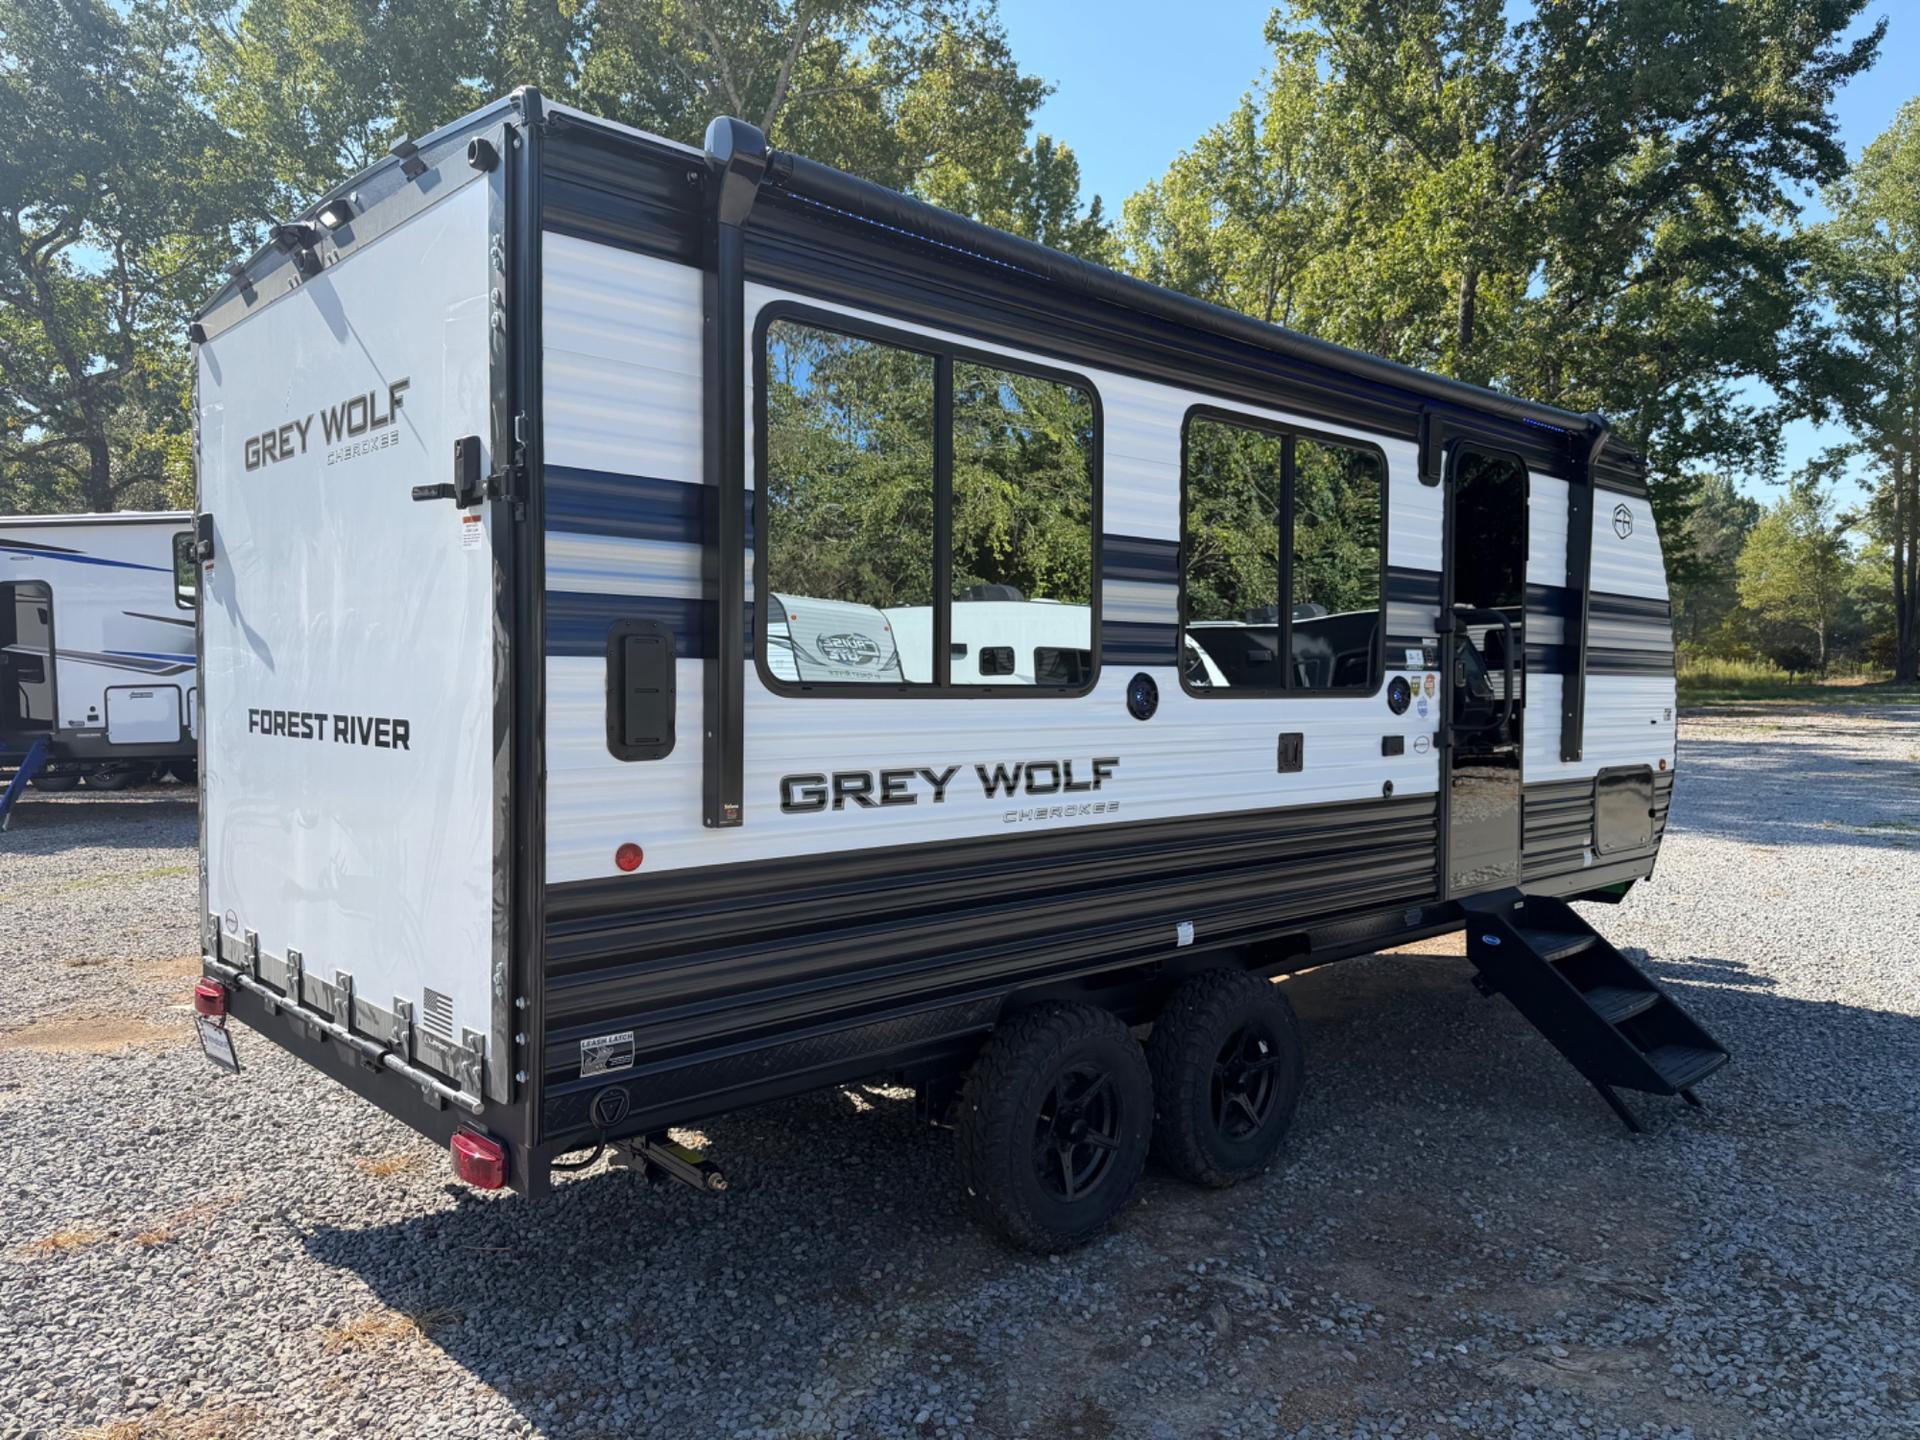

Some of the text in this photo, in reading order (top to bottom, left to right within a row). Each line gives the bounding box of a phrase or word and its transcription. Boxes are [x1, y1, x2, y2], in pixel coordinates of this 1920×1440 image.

[244, 376, 411, 472] GREY WOLF
[327, 430, 400, 466] CHEROKEE
[248, 708, 411, 751] FOREST RIVER
[779, 756, 1120, 814] GREY WOLF
[1002, 801, 1120, 823] CHEROKEE
